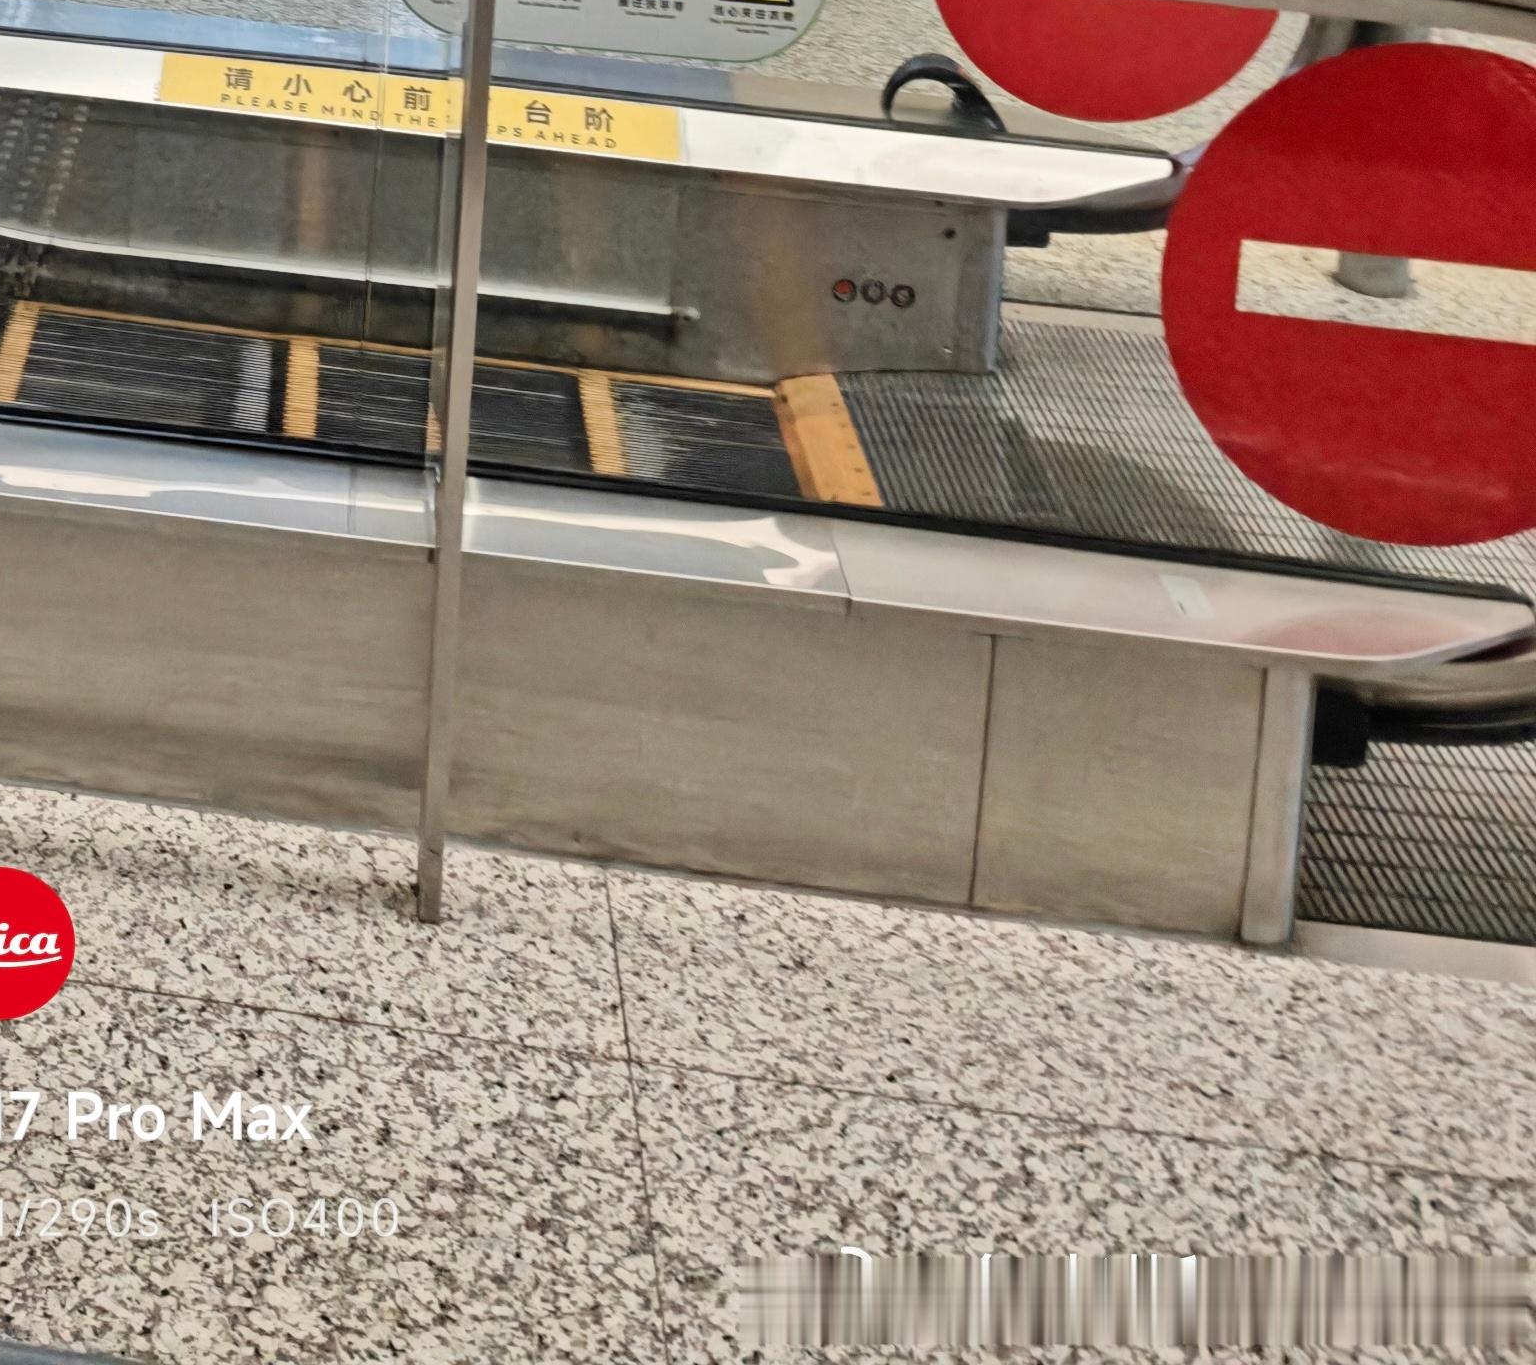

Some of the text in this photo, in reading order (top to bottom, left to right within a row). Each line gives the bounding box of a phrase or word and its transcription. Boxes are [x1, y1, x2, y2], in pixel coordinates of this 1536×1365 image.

[220, 92, 309, 113] PLEASE
[321, 104, 383, 121] MIND
[393, 112, 437, 128] THE
[534, 129, 618, 149] AHEAD
